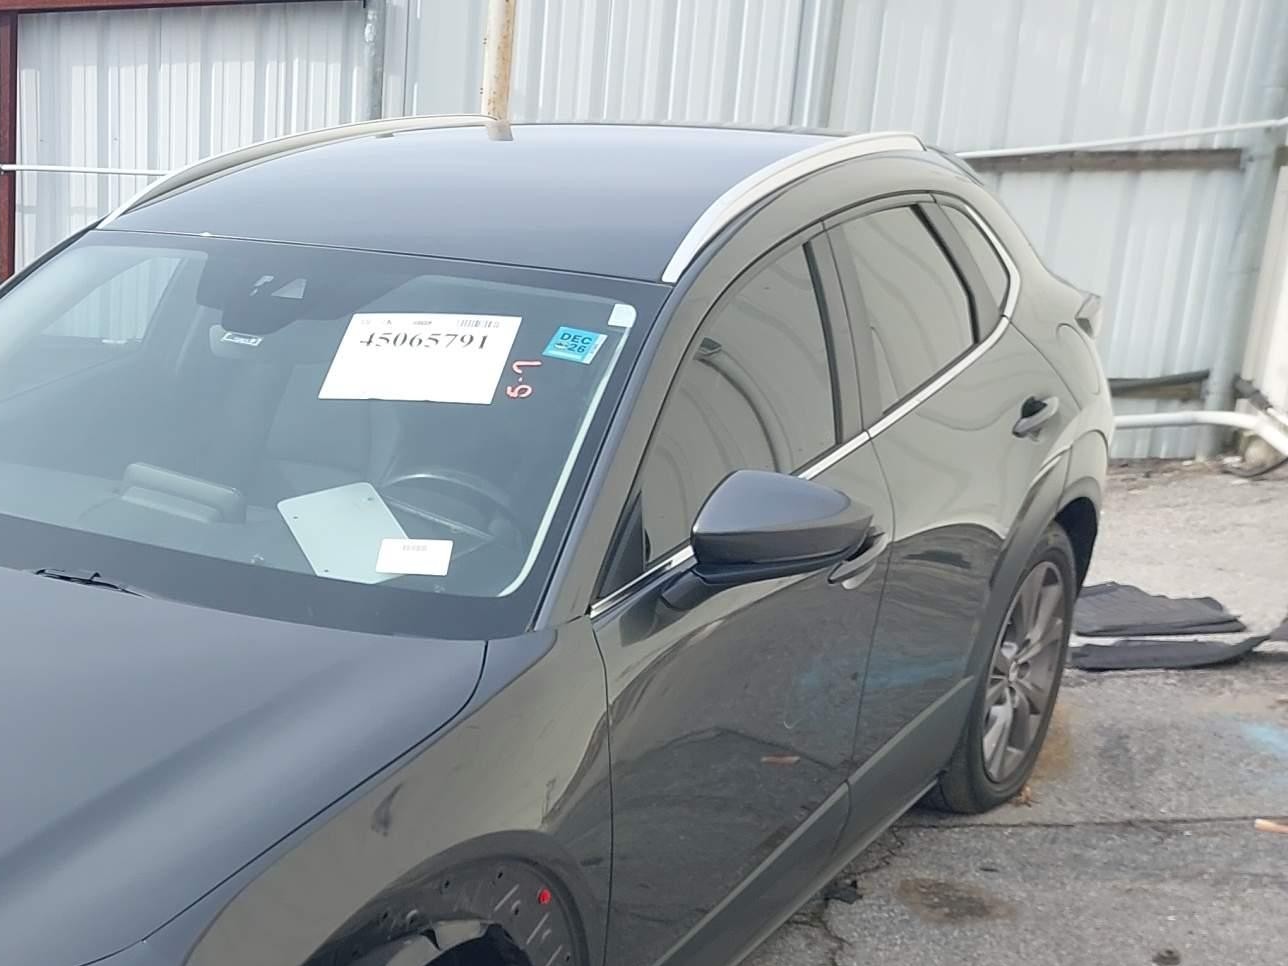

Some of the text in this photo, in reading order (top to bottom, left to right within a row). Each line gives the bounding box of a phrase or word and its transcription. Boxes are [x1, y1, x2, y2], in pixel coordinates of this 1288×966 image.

[359, 332, 489, 349] 45065791
[560, 332, 593, 345] DEC
[567, 343, 587, 354] 26
